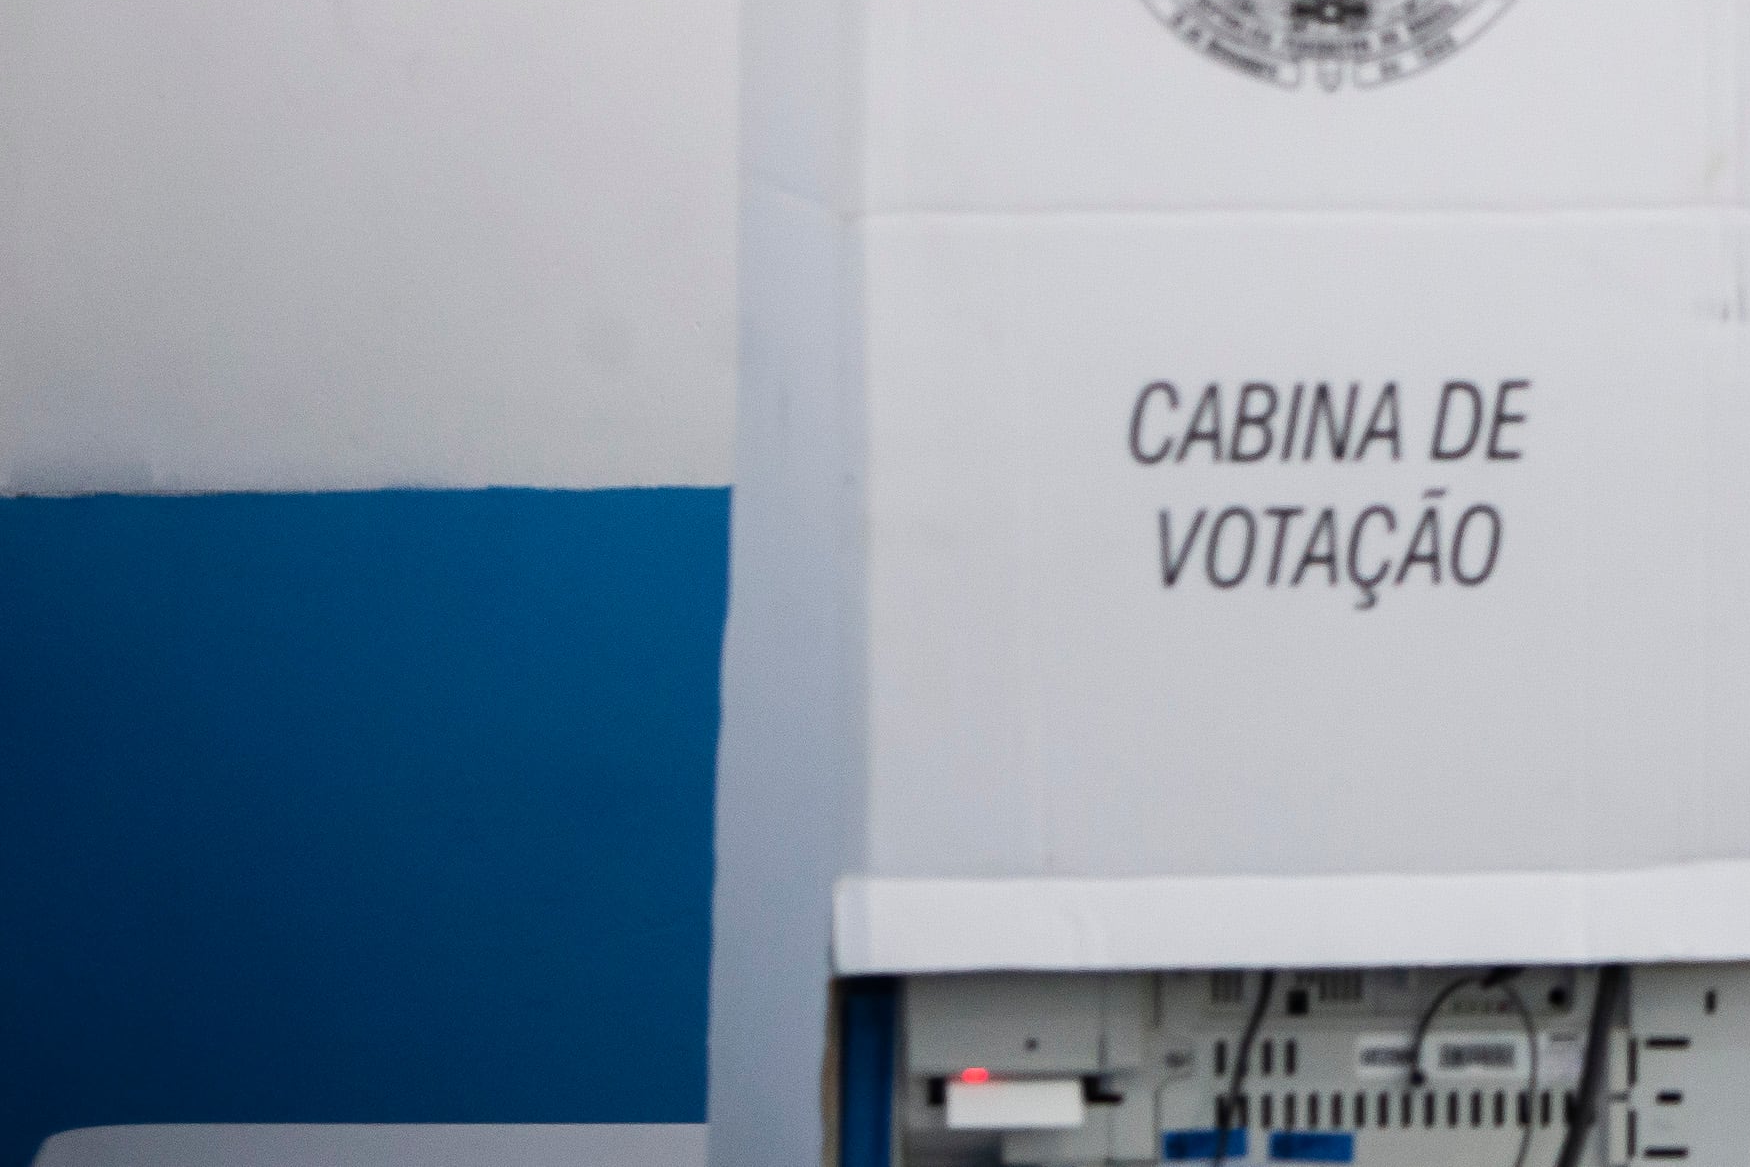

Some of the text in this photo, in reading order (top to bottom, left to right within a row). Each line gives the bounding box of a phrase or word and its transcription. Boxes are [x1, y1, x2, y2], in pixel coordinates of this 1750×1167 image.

[1126, 379, 1534, 467] CABINA DE
[1157, 488, 1506, 611] VOTAÇÃO
